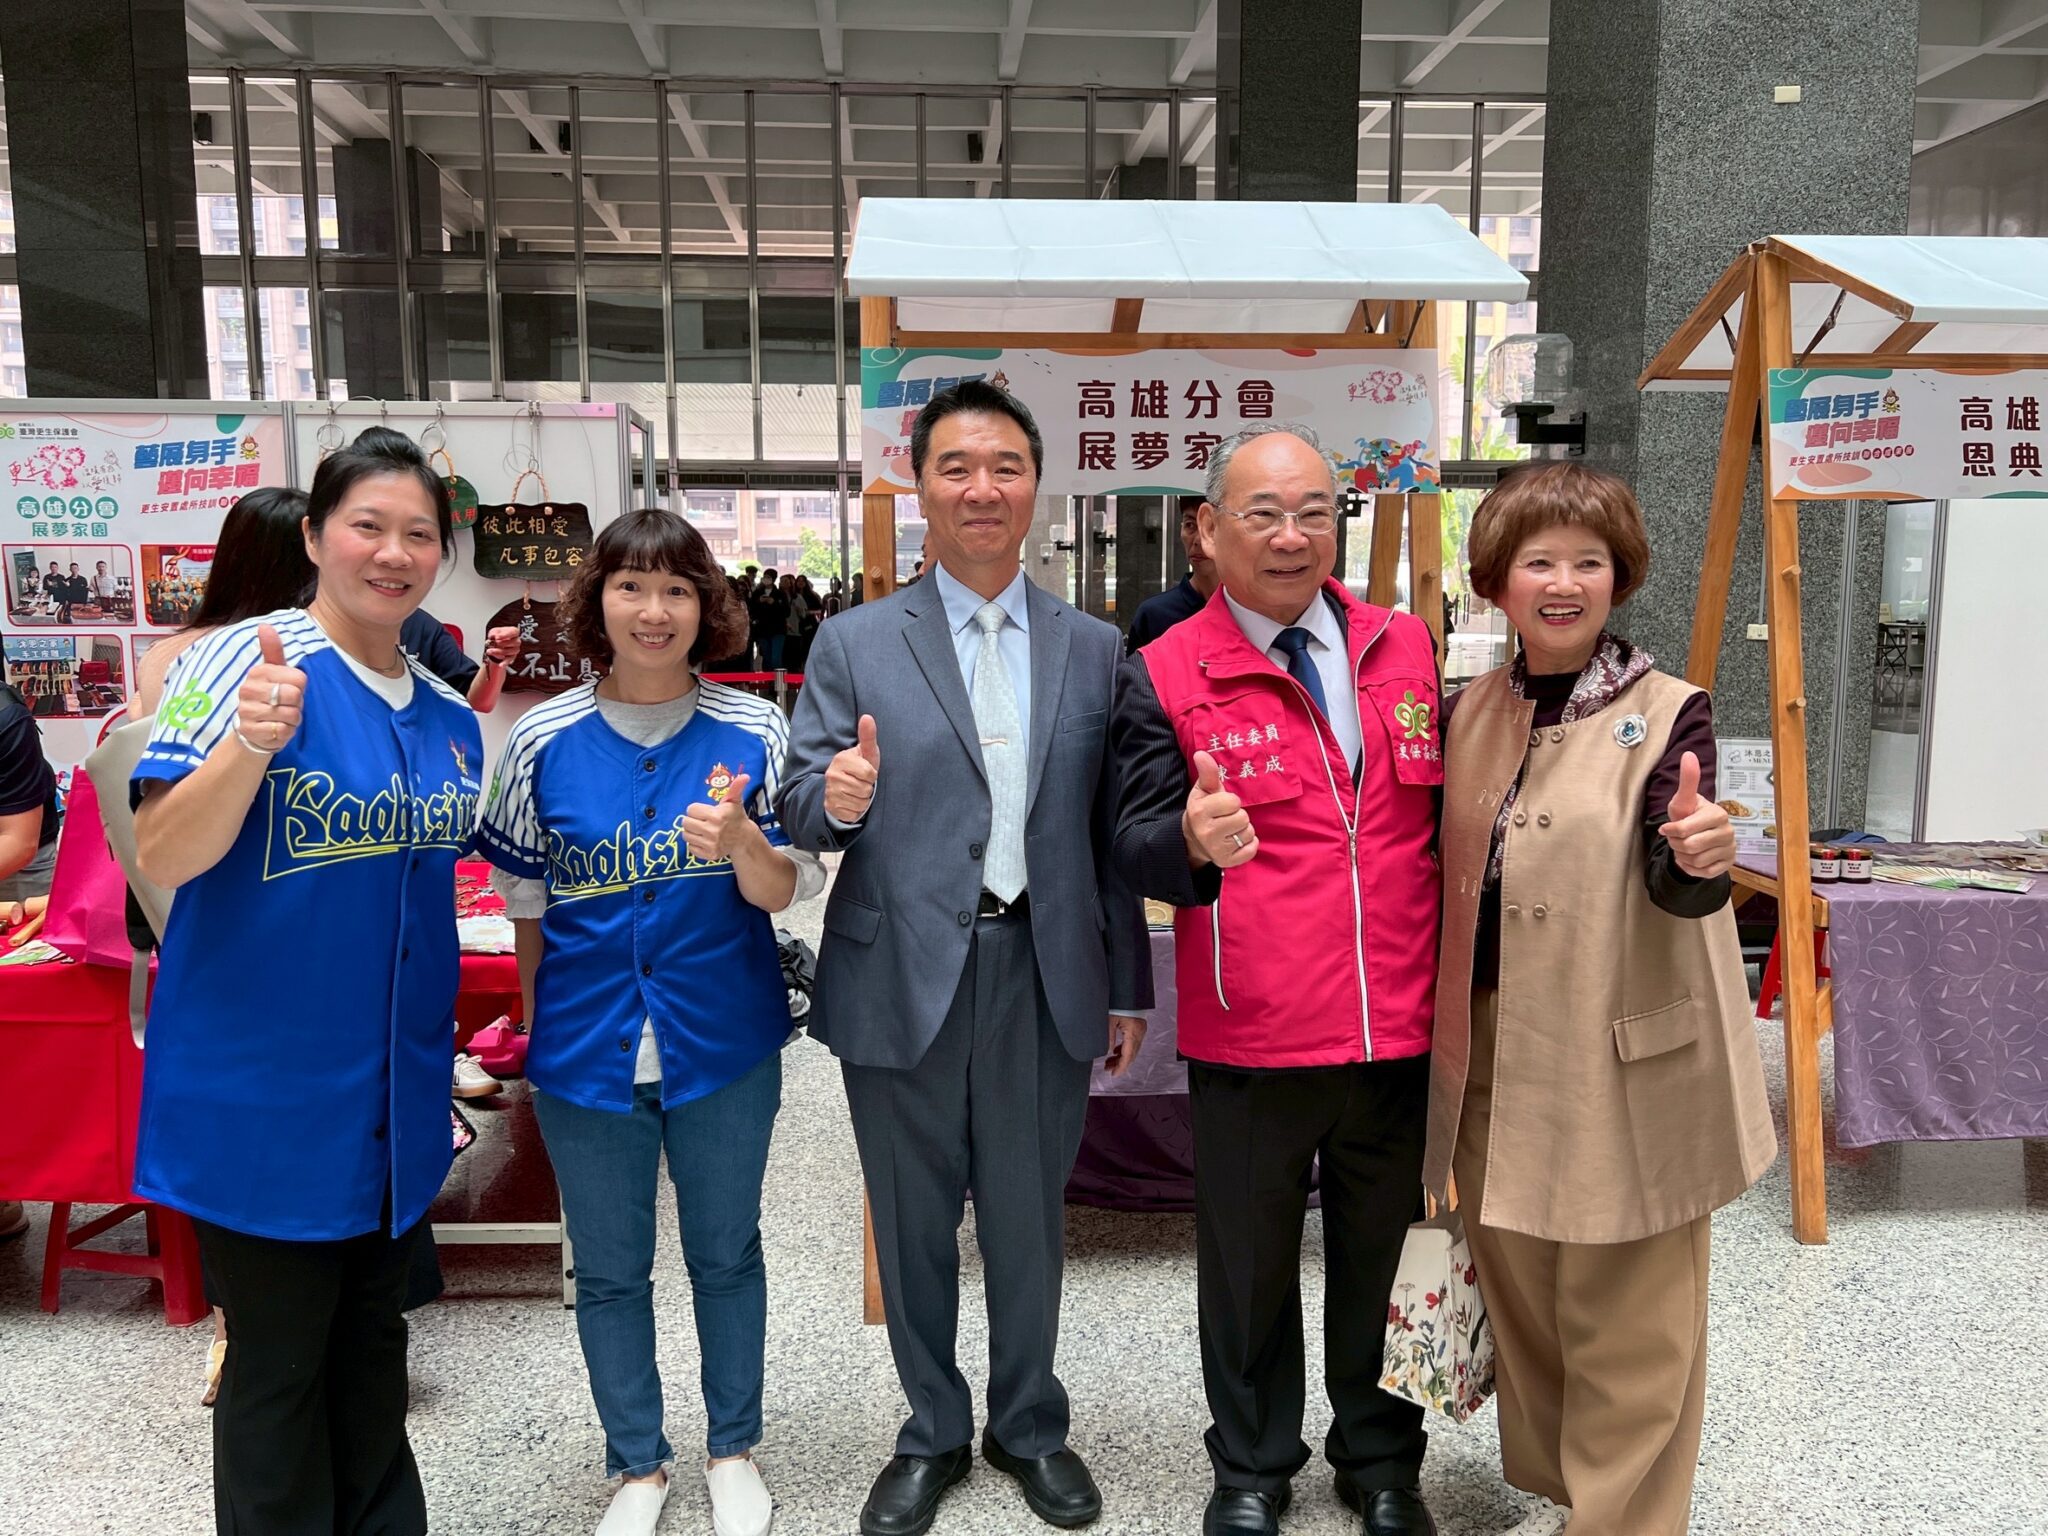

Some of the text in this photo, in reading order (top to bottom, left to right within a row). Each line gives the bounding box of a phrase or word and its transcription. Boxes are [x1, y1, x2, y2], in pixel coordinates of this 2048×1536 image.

[877, 373, 987, 409] 藝展
[1077, 380, 1276, 419] 高雄分會
[1784, 391, 1880, 423] 藝展身手
[1959, 396, 2041, 431] 高雄
[1804, 415, 1901, 449] 邁向幸福
[134, 436, 237, 470] 藝展身手
[1077, 431, 1223, 470] 展夢家
[1962, 442, 2043, 477] 恩典
[157, 462, 261, 496] 邁向幸福
[19, 499, 117, 517] 高雄分會
[32, 521, 109, 537] 展夢家園
[482, 515, 569, 537] 彼此相愛
[500, 545, 584, 567] 凡事包容
[506, 652, 601, 681] 不止息
[1207, 723, 1280, 753] 主任委員
